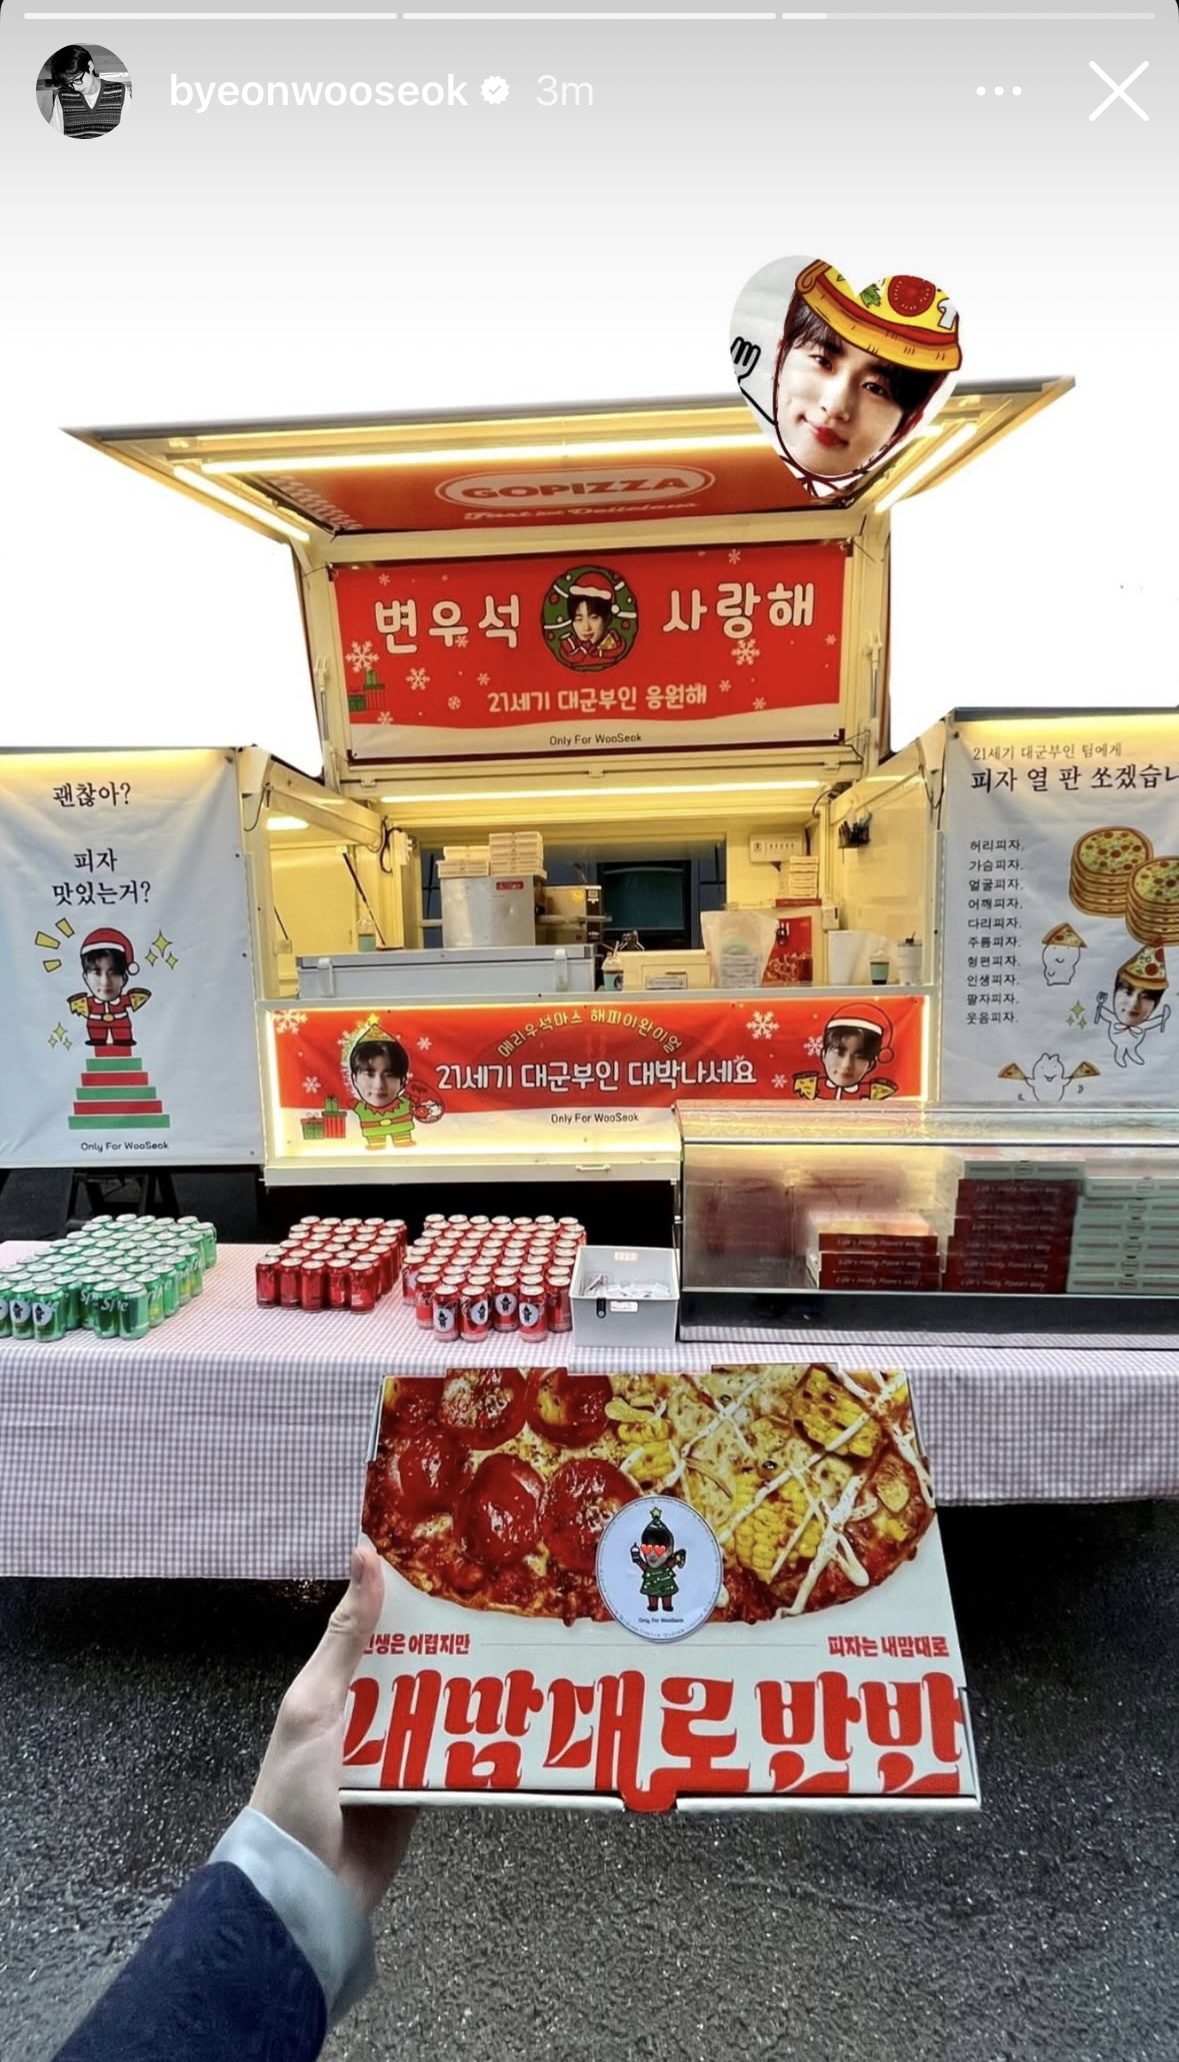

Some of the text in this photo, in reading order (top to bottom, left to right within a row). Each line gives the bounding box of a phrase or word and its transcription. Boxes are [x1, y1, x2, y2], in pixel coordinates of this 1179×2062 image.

[461, 477, 690, 498] GOPIZZA
[488, 683, 707, 713] 21세기 대군부인 응원해
[549, 732, 642, 747] Only For WooSeok
[973, 742, 1122, 761] 21세기 대군부인 팀에게
[970, 767, 1017, 793] 피자
[1027, 766, 1048, 792] 열
[1058, 765, 1082, 791] 판
[52, 781, 132, 807] 괜찮아?
[74, 848, 118, 873] 피자
[52, 880, 151, 906] 맛있는거?
[497, 1010, 583, 1058] 메리우석마스
[435, 1059, 757, 1092] 21세기 대군부인 대박나세요
[551, 1111, 640, 1124] Only For WooSeok
[80, 1141, 169, 1152] Only For WooSeok
[408, 1633, 471, 1655] 어렵지만
[828, 1635, 950, 1658] 피자는 내맘대로
